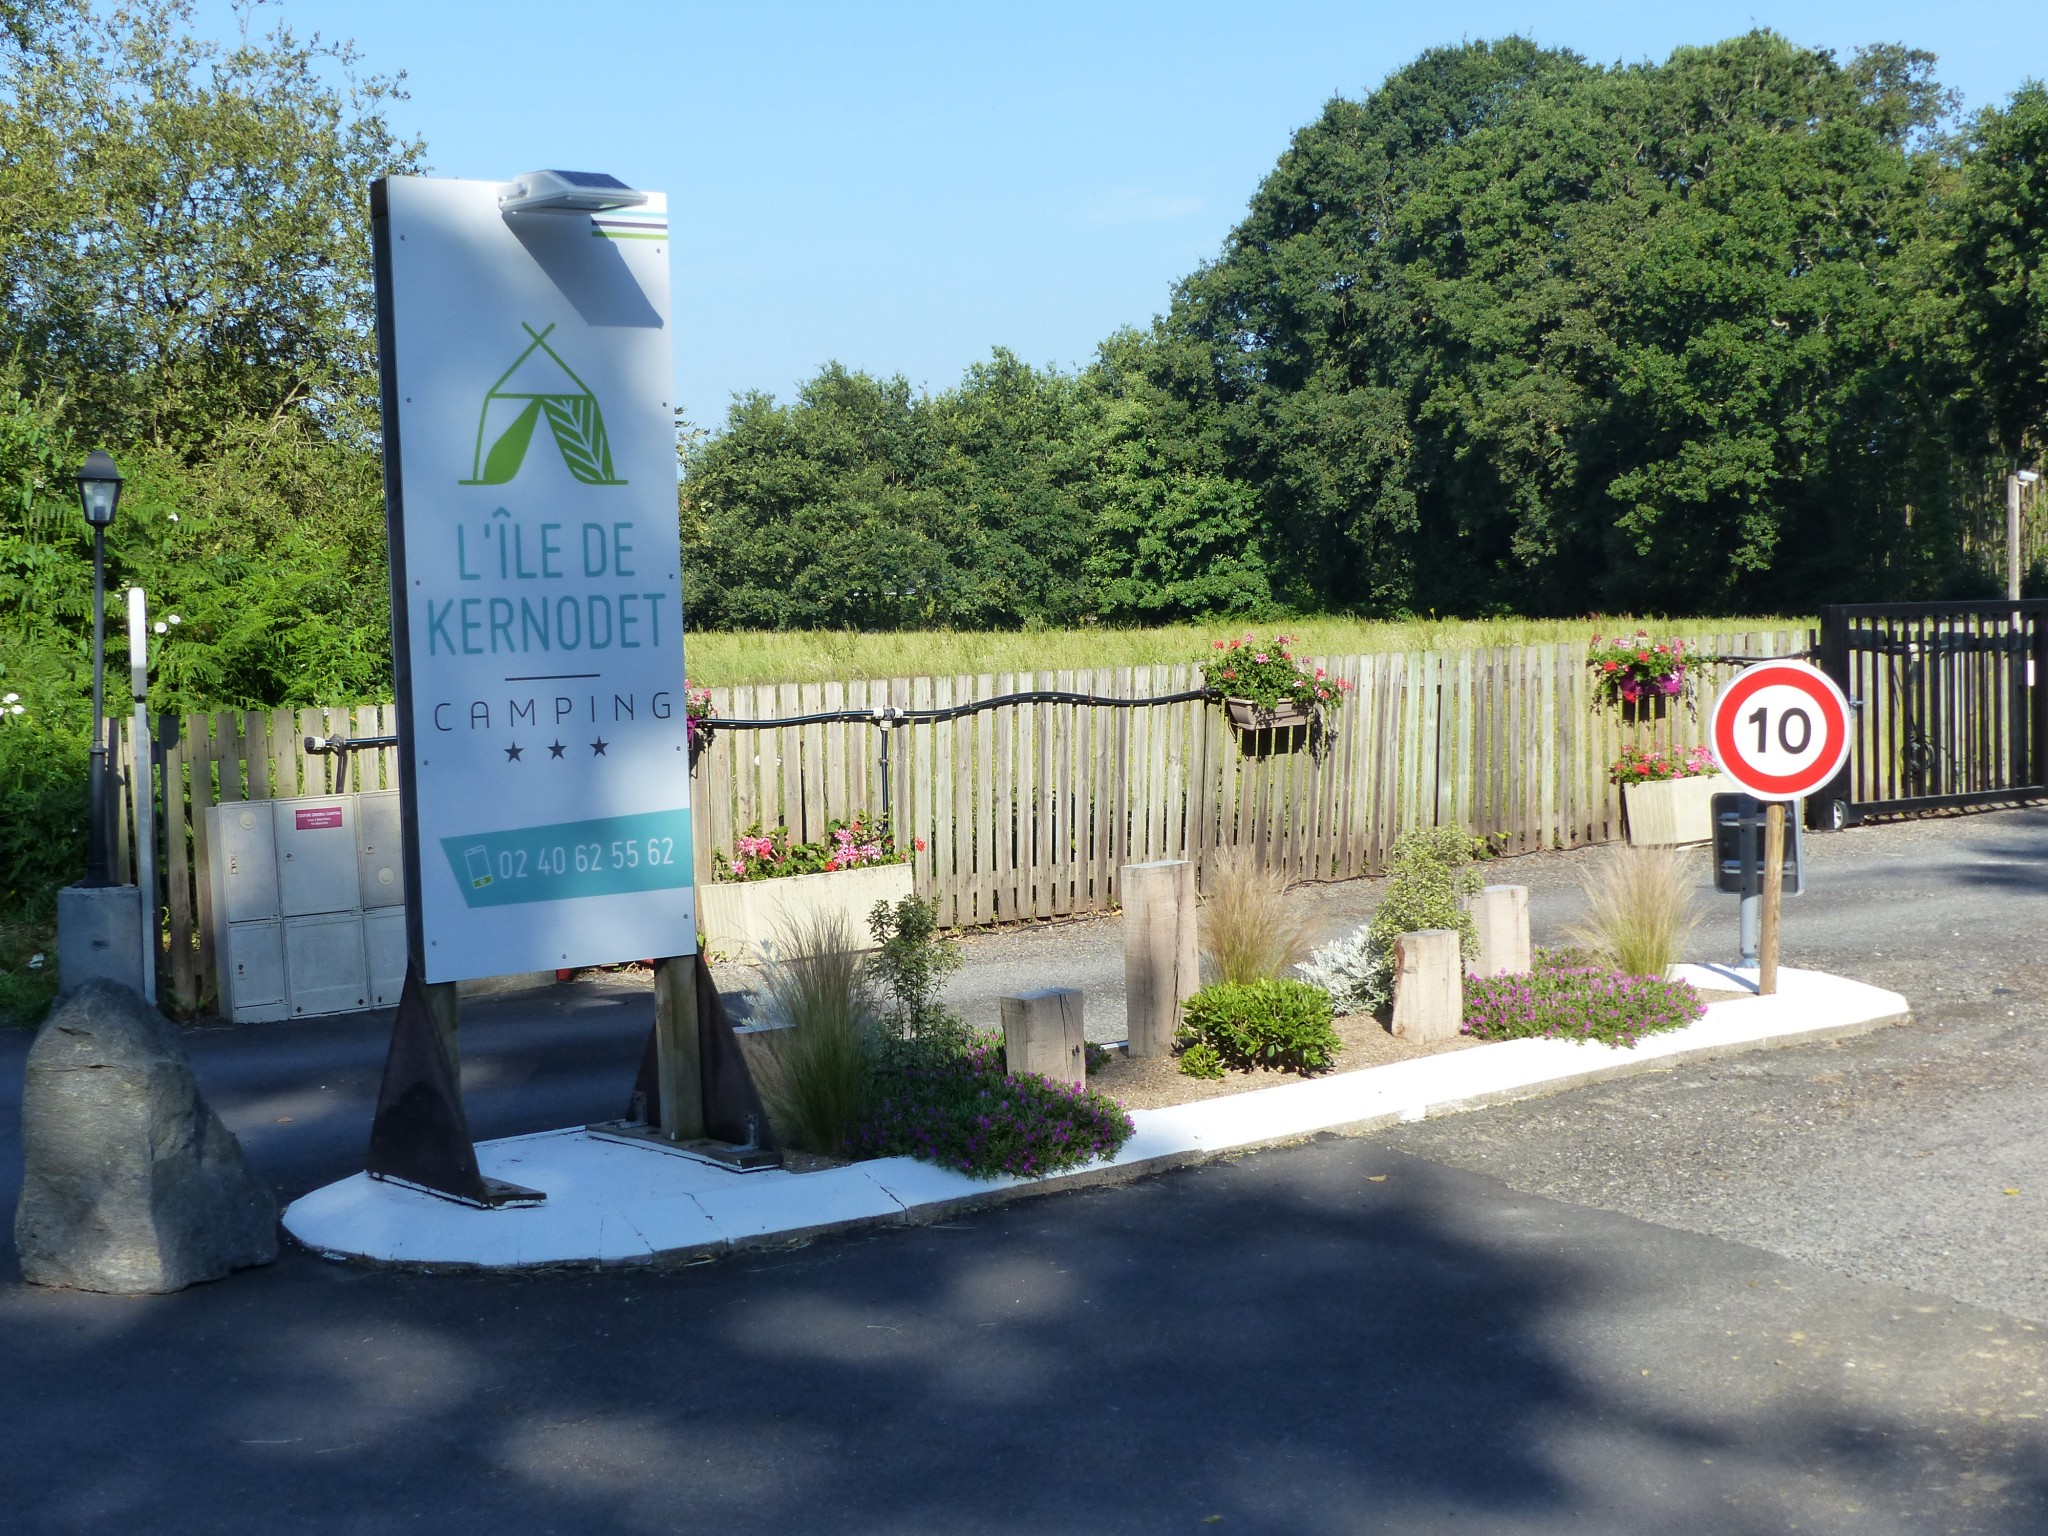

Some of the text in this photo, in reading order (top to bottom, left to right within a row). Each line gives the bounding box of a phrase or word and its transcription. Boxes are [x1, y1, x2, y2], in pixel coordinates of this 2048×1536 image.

[457, 506, 635, 580] L'ÎLE DE
[427, 593, 666, 657] KERNODET
[434, 691, 672, 731] CAMPING
[1748, 706, 1812, 754] 10
[499, 837, 675, 879] 02 40 62 55 62
